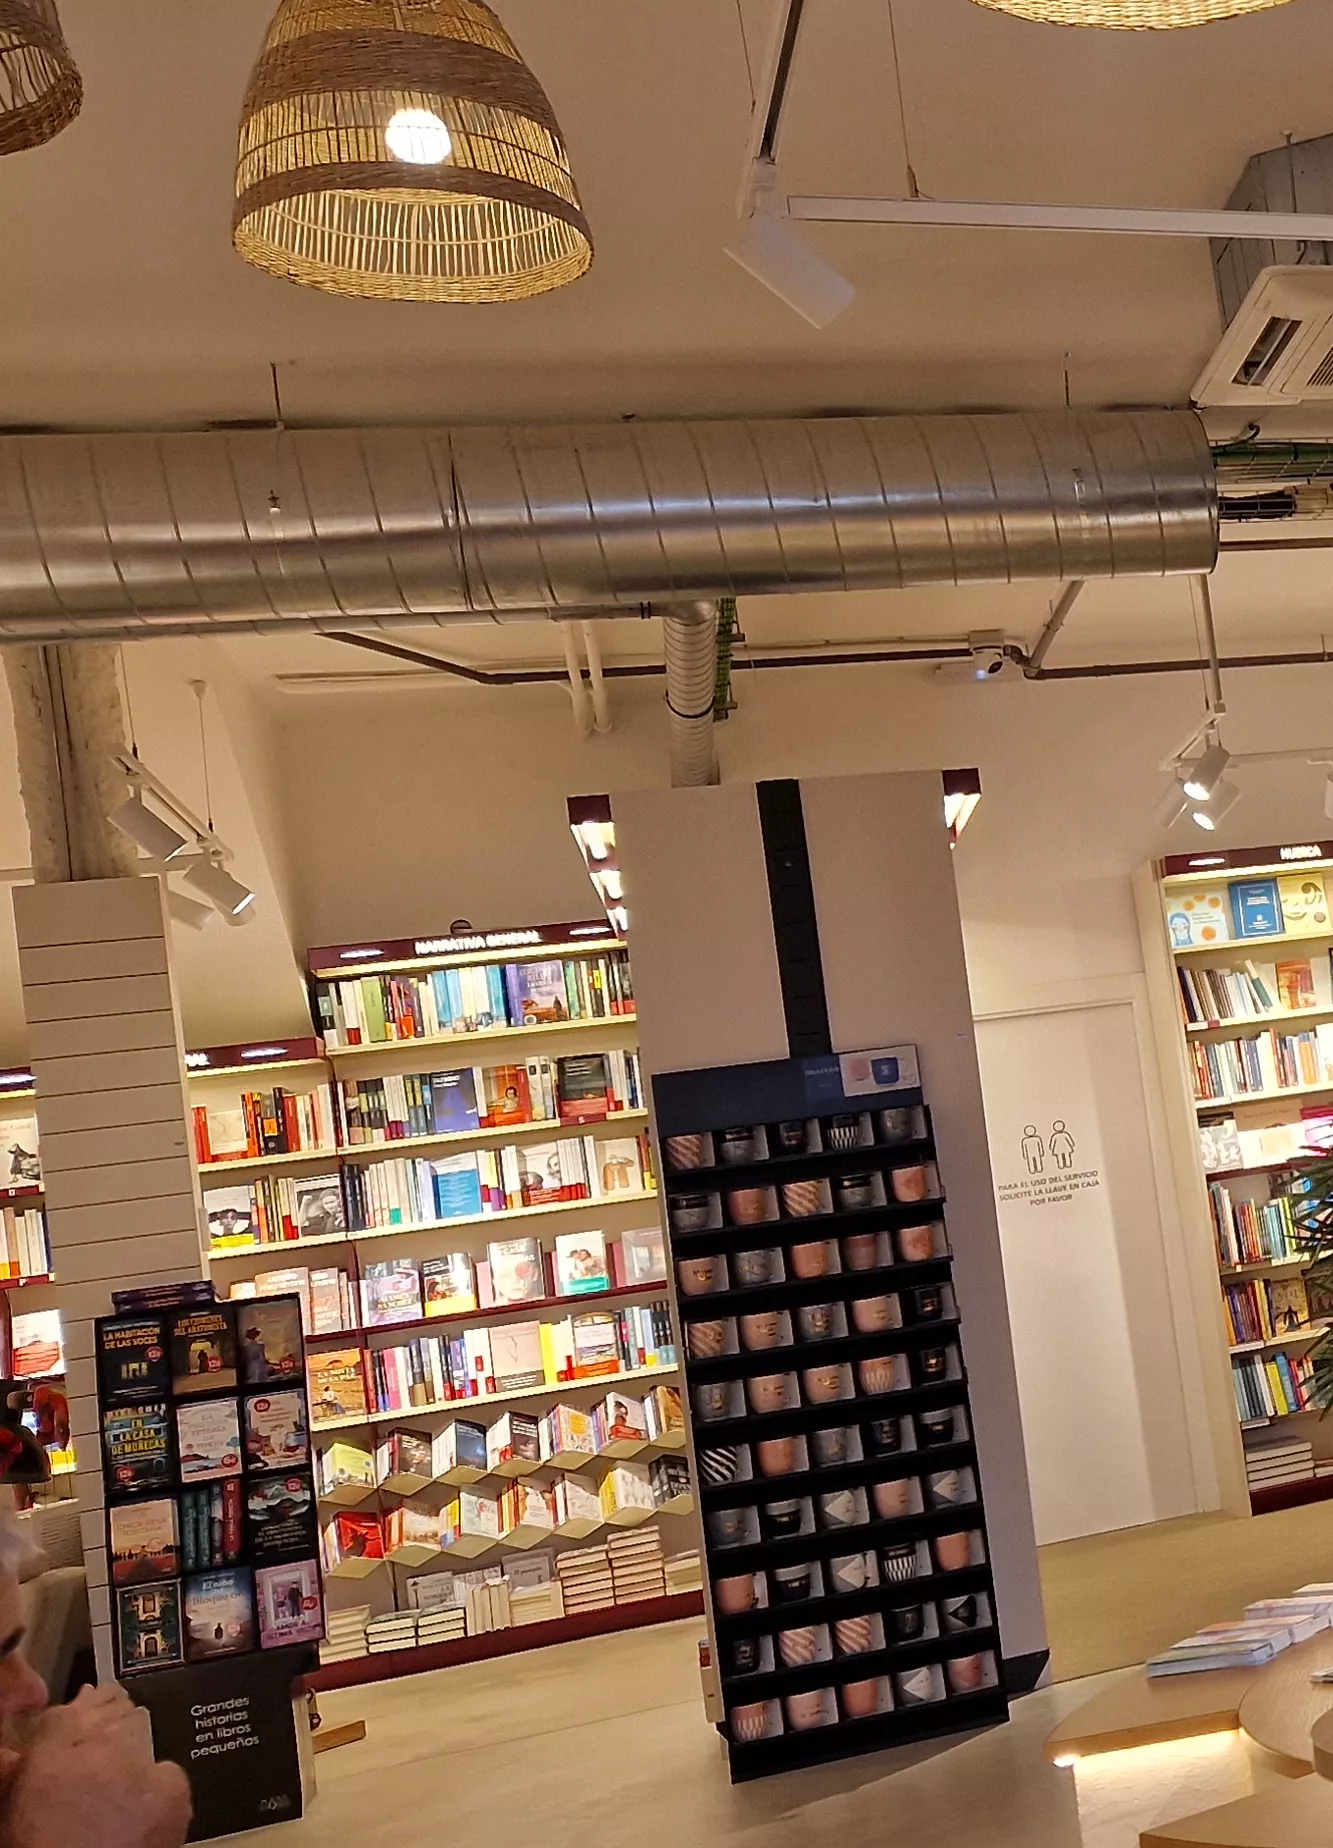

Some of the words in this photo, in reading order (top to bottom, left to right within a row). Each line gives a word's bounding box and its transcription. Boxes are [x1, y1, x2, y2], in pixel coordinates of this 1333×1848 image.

[414, 936, 486, 955] NARRATIVA
[486, 930, 542, 948] GENERAL
[998, 1182, 1019, 1192] PARA
[1020, 1181, 1029, 1189] EL
[1030, 1178, 1047, 1187] USO
[1048, 1175, 1063, 1185] DEL
[1063, 1170, 1099, 1182] SERVICIO
[999, 1189, 1033, 1202] SOLICITE
[1033, 1188, 1044, 1197] LA
[1045, 1185, 1068, 1195] LLAVE
[1069, 1182, 1080, 1191] EN
[1081, 1179, 1100, 1189] CAJA
[1030, 1198, 1046, 1207] POR
[1047, 1193, 1073, 1204] FAVOR
[103, 1331, 114, 1342] LA
[115, 1327, 161, 1341] HABITACIÓN
[105, 1339, 117, 1350] DE
[117, 1337, 132, 1348] LAS
[132, 1335, 158, 1346] VOCES
[131, 1418, 143, 1429] EN
[120, 1432, 131, 1442] LA
[132, 1429, 156, 1441] CASA
[111, 1446, 124, 1455] DE
[190, 1696, 250, 1717] Grandes
[195, 1710, 249, 1730] historias
[195, 1733, 214, 1743] en
[216, 1723, 252, 1739] libros
[190, 1735, 260, 1760] pequeños
